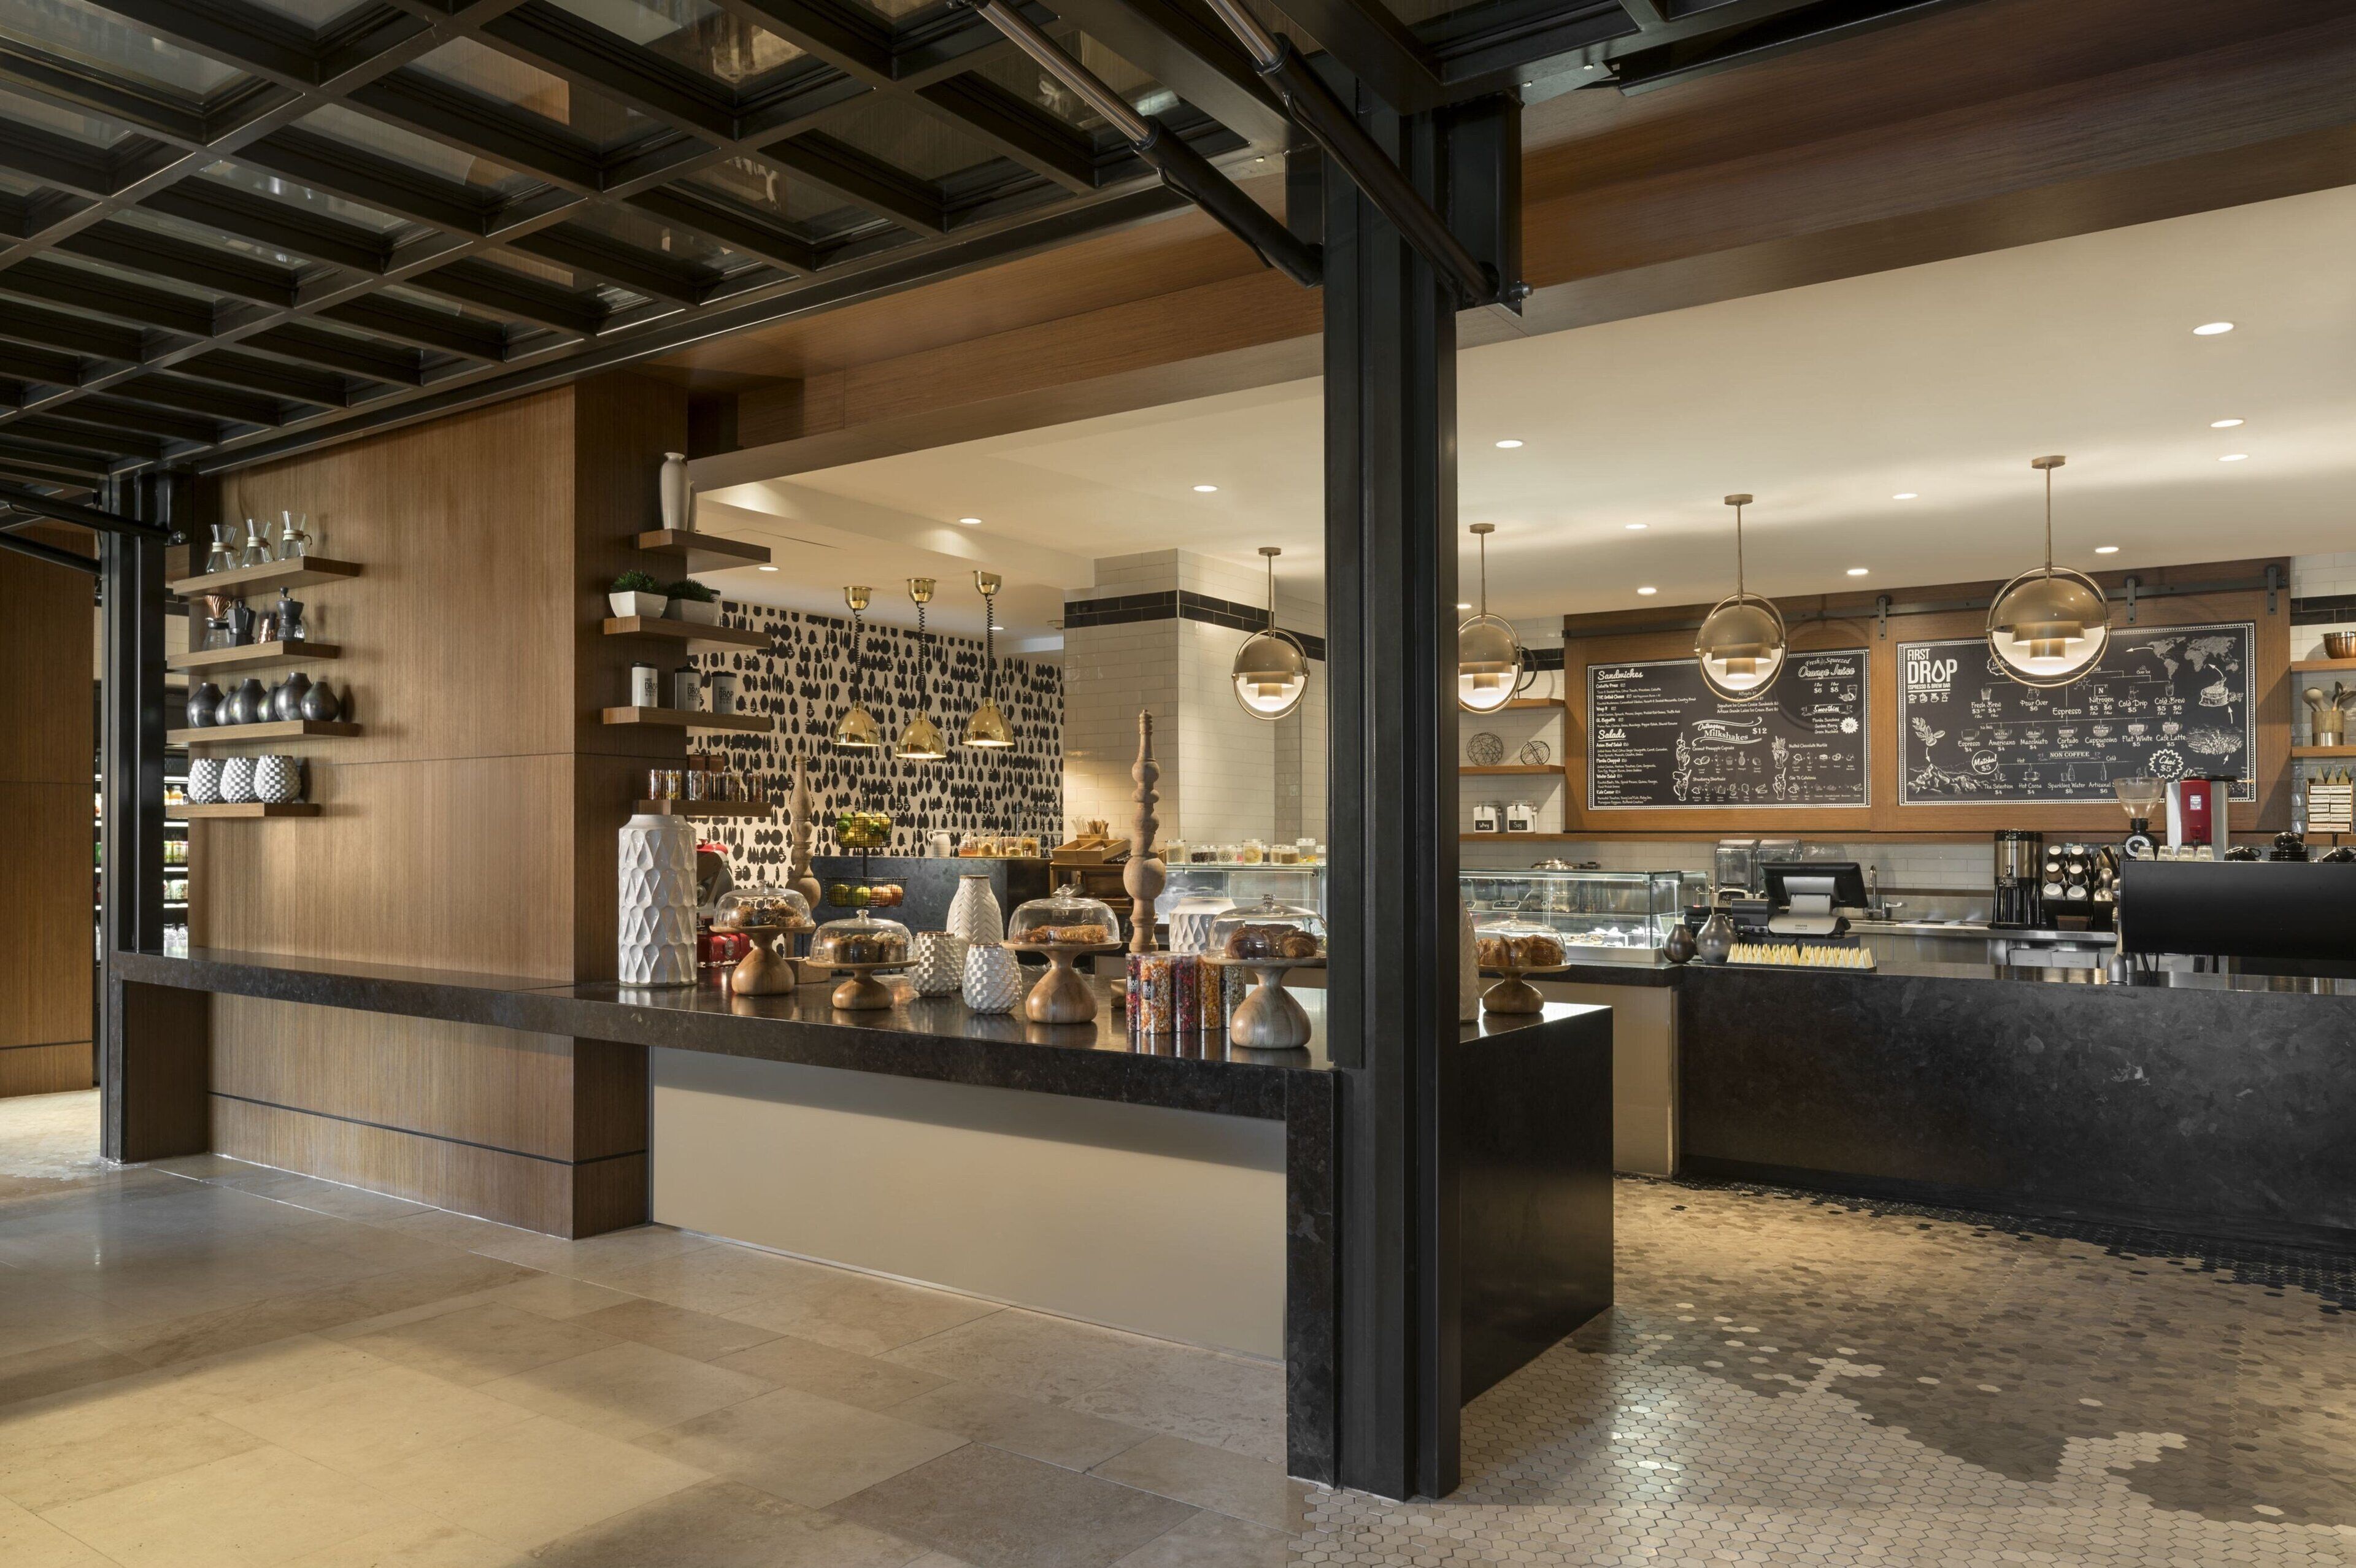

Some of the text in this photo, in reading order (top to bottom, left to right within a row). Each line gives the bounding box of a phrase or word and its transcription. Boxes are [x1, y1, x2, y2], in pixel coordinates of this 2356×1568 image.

[1908, 648, 1930, 661] FIRST
[1805, 657, 1852, 666] Fresh Squeezed
[1598, 668, 1644, 680] Sandwiches
[1798, 664, 1856, 680] Orange Juice
[1908, 659, 1957, 684] DROP
[2088, 697, 2114, 706] Nitrogen
[2132, 699, 2148, 709] Drip
[2052, 707, 2082, 718] Espresso
[1598, 728, 1626, 740] Salads
[1704, 729, 1749, 740] Milkshakes
[1957, 740, 1981, 748] Espresso
[2085, 737, 2118, 746] Cappuccino
[1974, 754, 1998, 766] Matcha!
[2159, 755, 2176, 765] Chai
